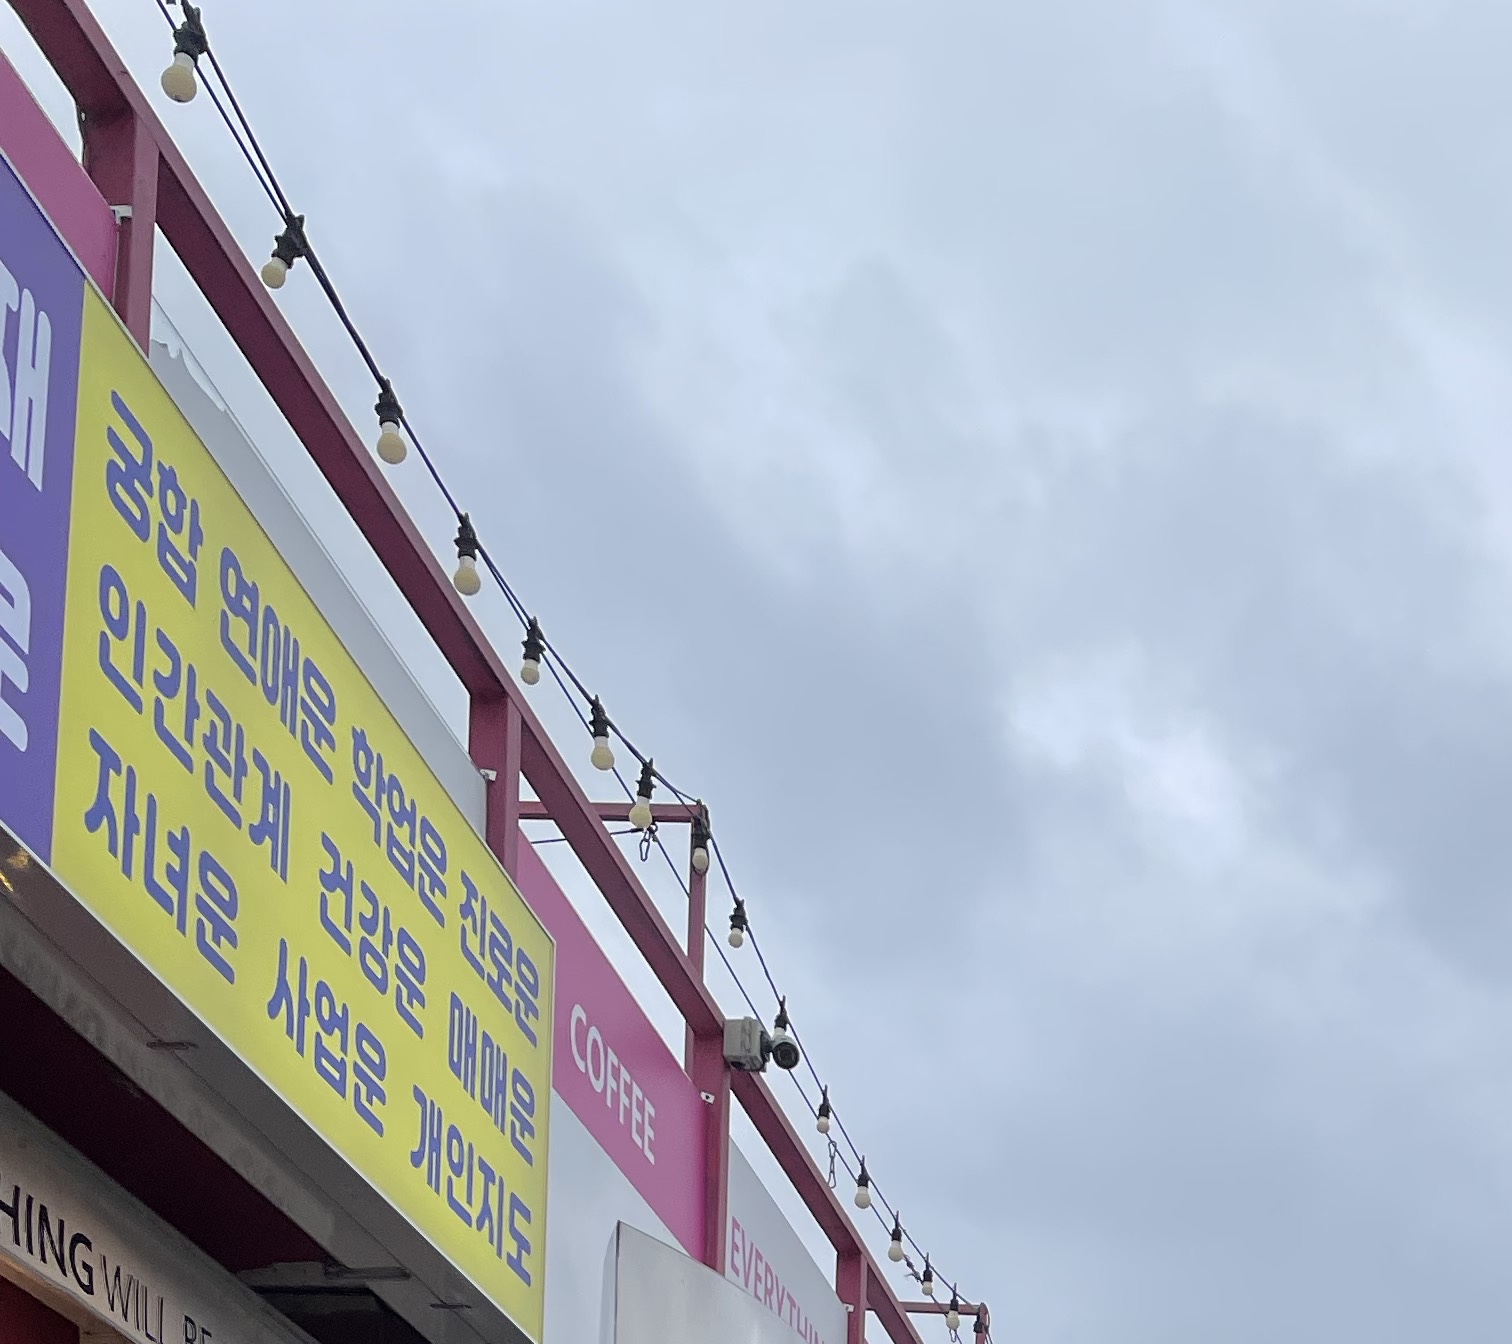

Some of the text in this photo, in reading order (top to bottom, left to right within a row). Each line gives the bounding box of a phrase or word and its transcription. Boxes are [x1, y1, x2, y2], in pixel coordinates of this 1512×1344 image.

[85, 728, 533, 1287] 자녀운 사업운 개인지도
[99, 565, 537, 1166] 인간관계 건강운 매매운
[106, 391, 539, 1048] 궁합 연애운 학업운 진로운
[569, 1003, 656, 1166] COFFEE
